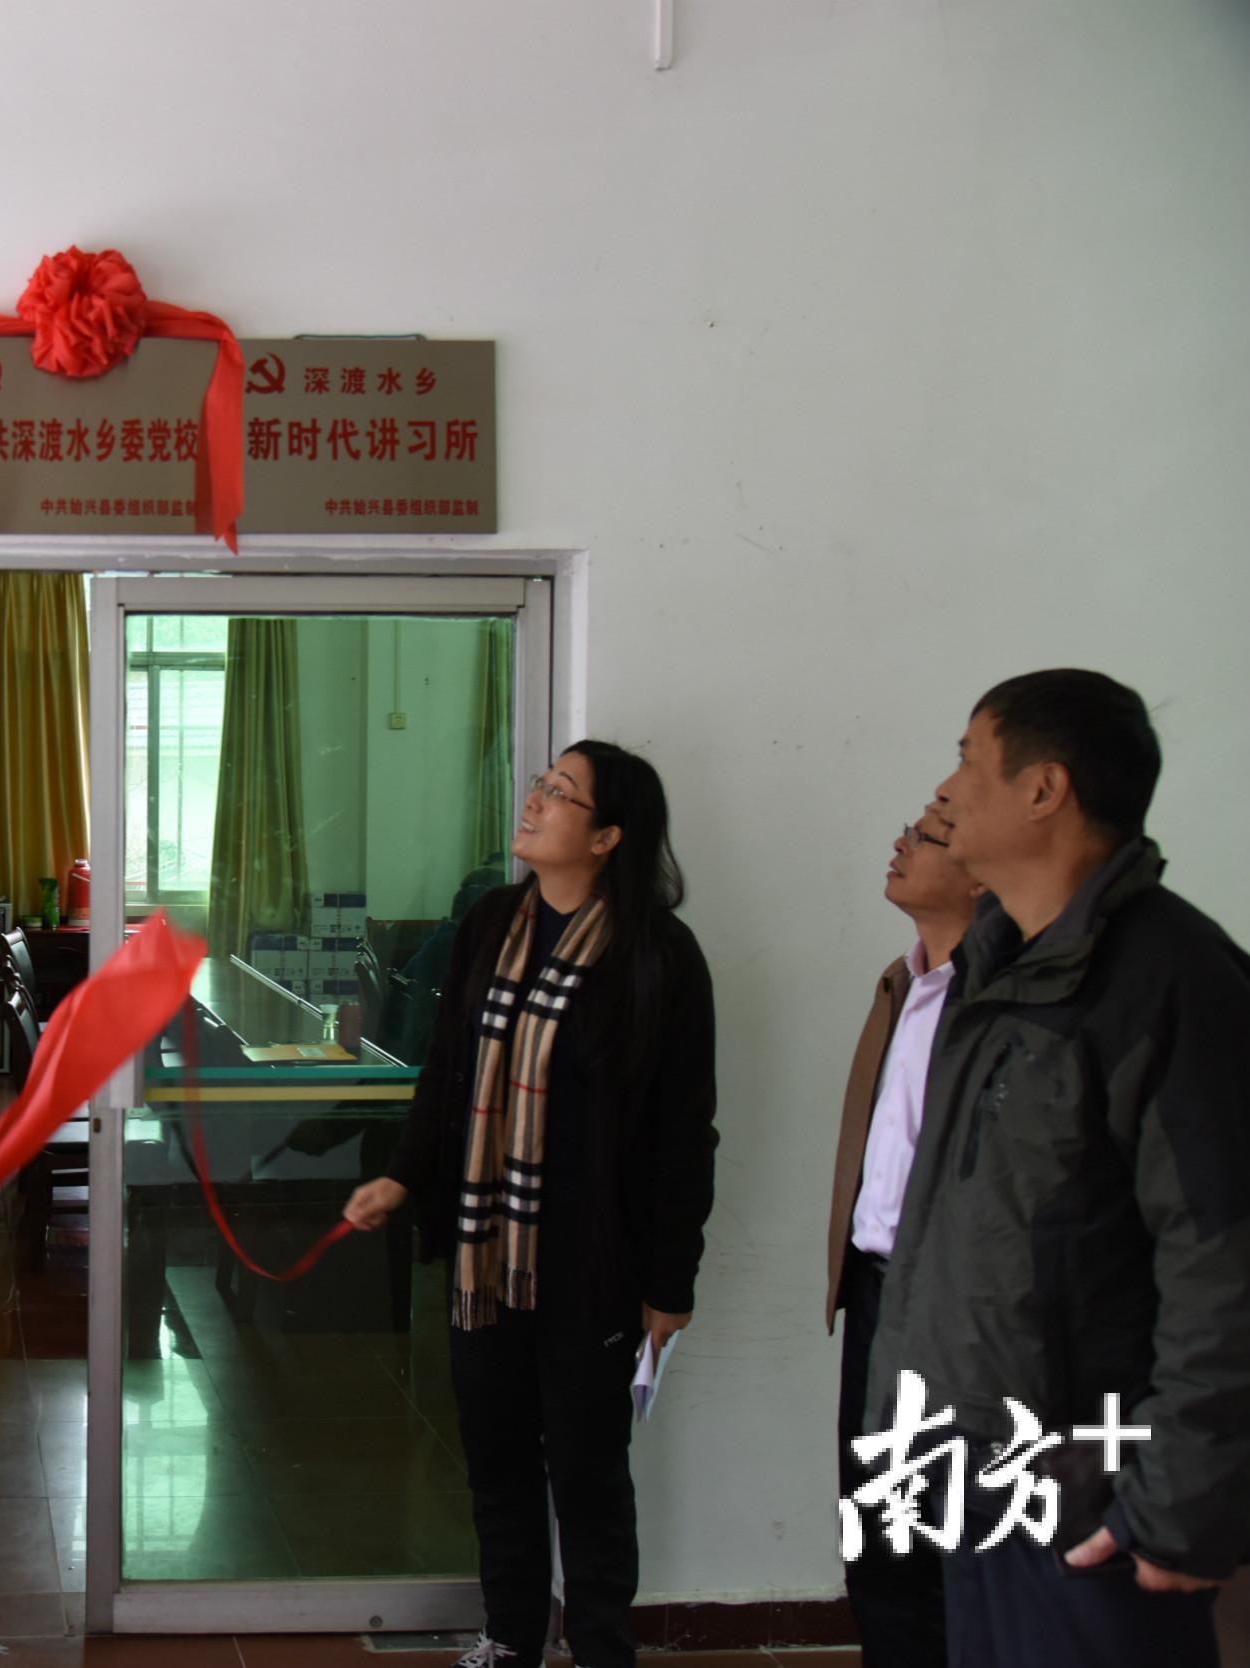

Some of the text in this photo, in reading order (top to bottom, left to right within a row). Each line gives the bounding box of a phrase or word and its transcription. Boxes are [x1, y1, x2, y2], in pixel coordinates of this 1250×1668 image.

[304, 367, 437, 395] 深渡水乡
[247, 416, 478, 461] 新时代讲习所
[325, 499, 478, 516] 中共始兴县委组织部监制
